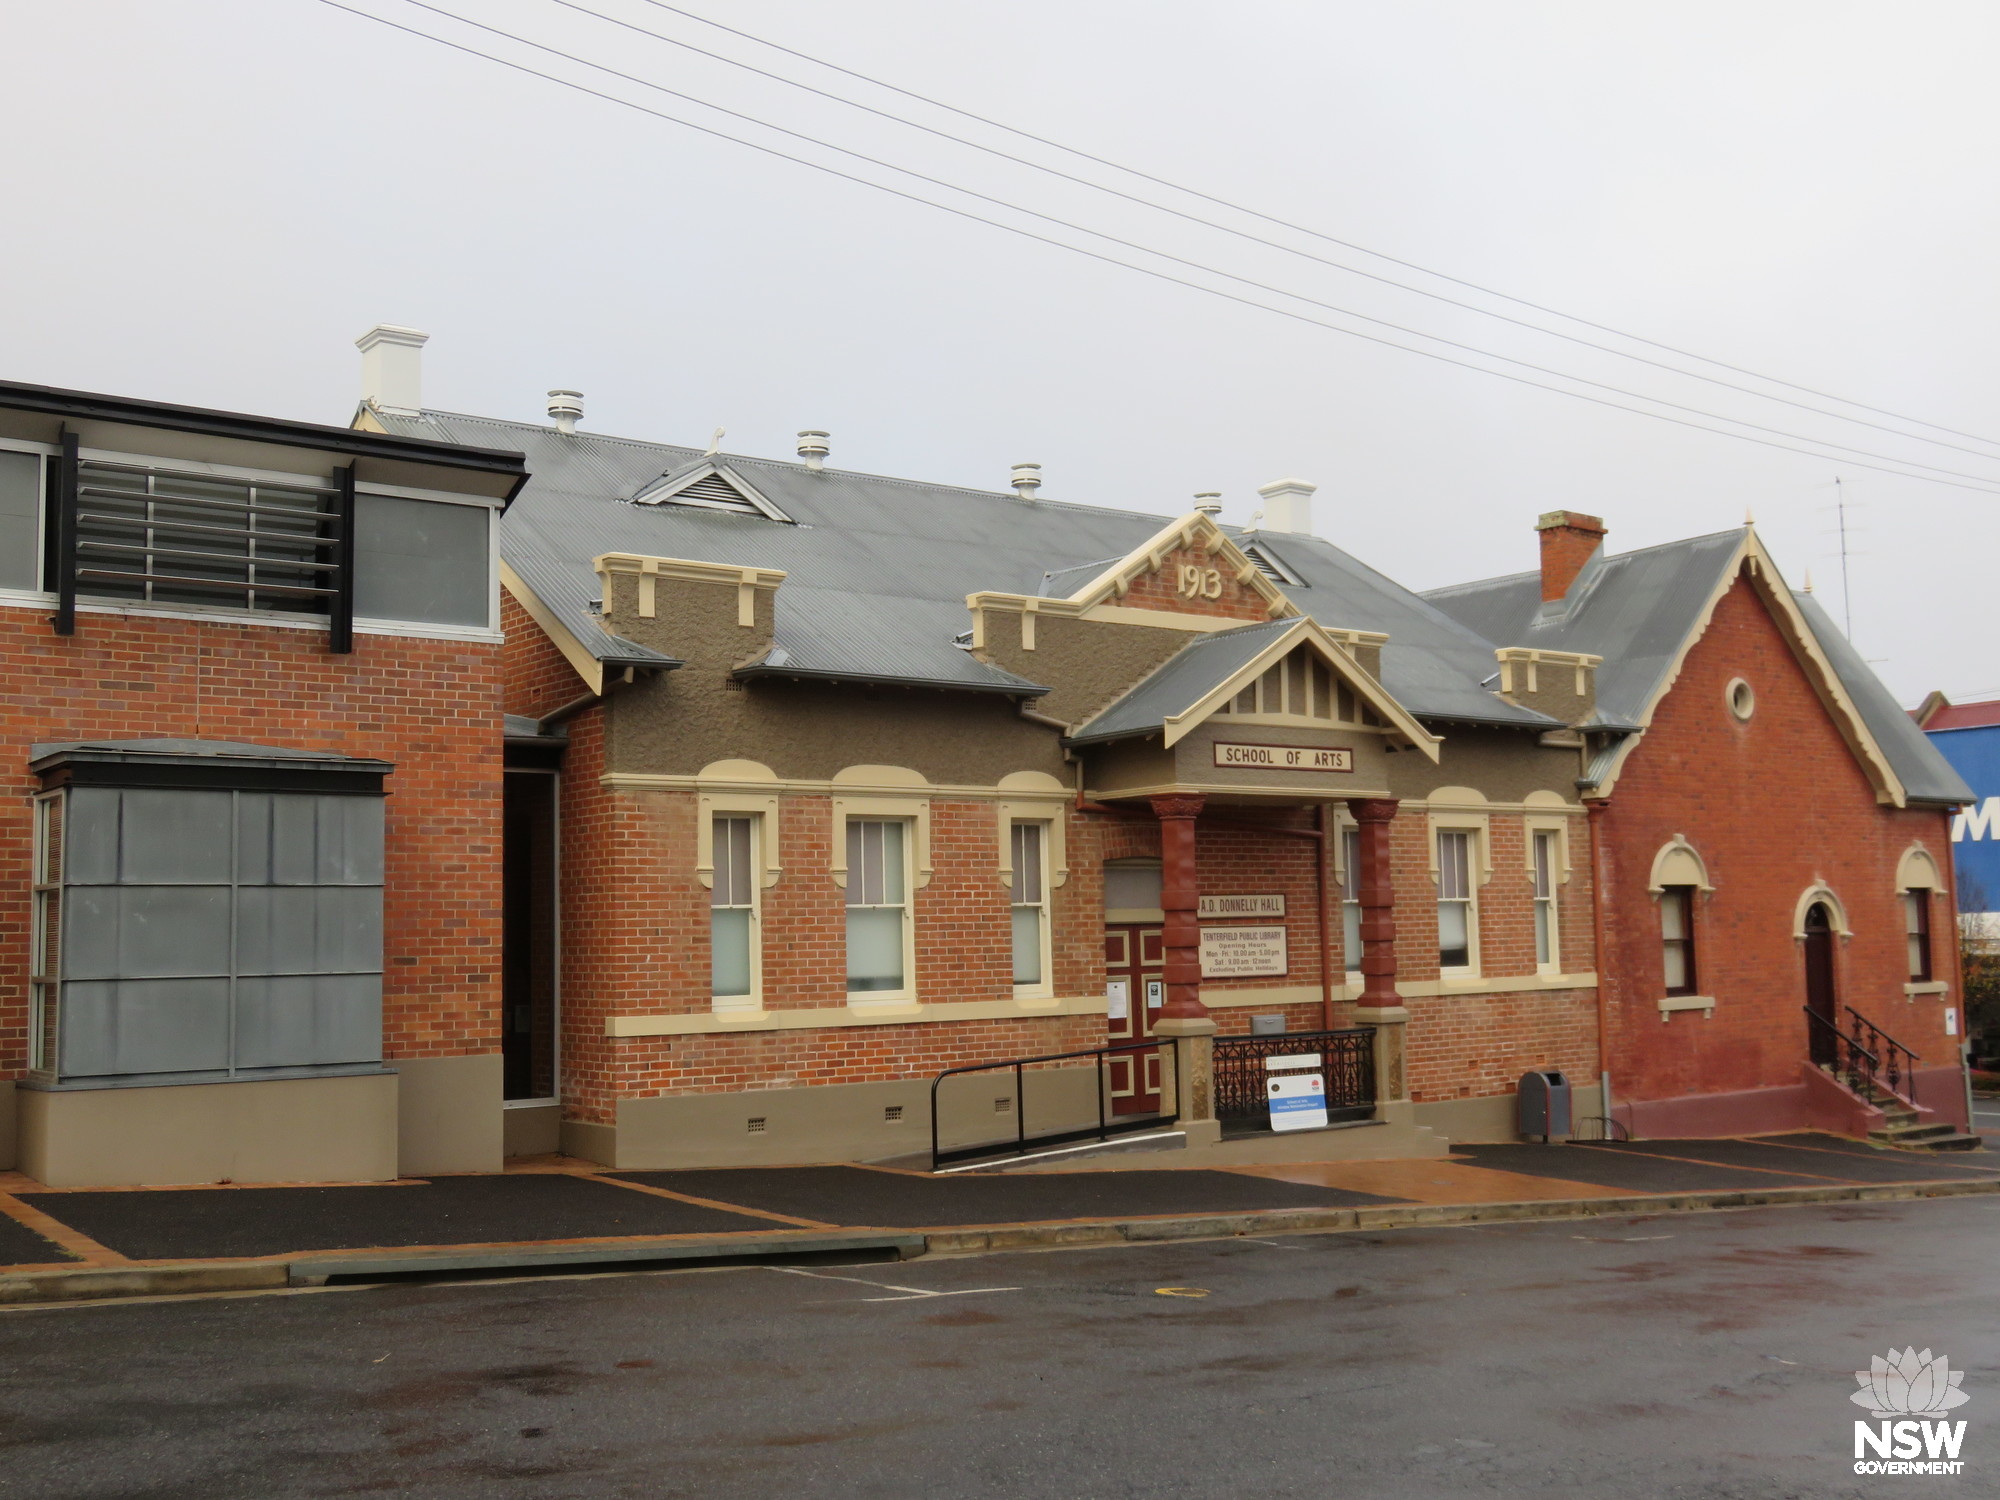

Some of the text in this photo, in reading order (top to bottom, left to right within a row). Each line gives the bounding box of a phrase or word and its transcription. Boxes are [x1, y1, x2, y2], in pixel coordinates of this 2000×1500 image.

[1177, 564, 1222, 600] 1913
[1226, 747, 1343, 767] SCHOOL OF ARTS
[1201, 898, 1280, 912] A.D. DONNELLY HALL
[1203, 931, 1281, 941] TENTERFIELD PUBLIC LIBRARY
